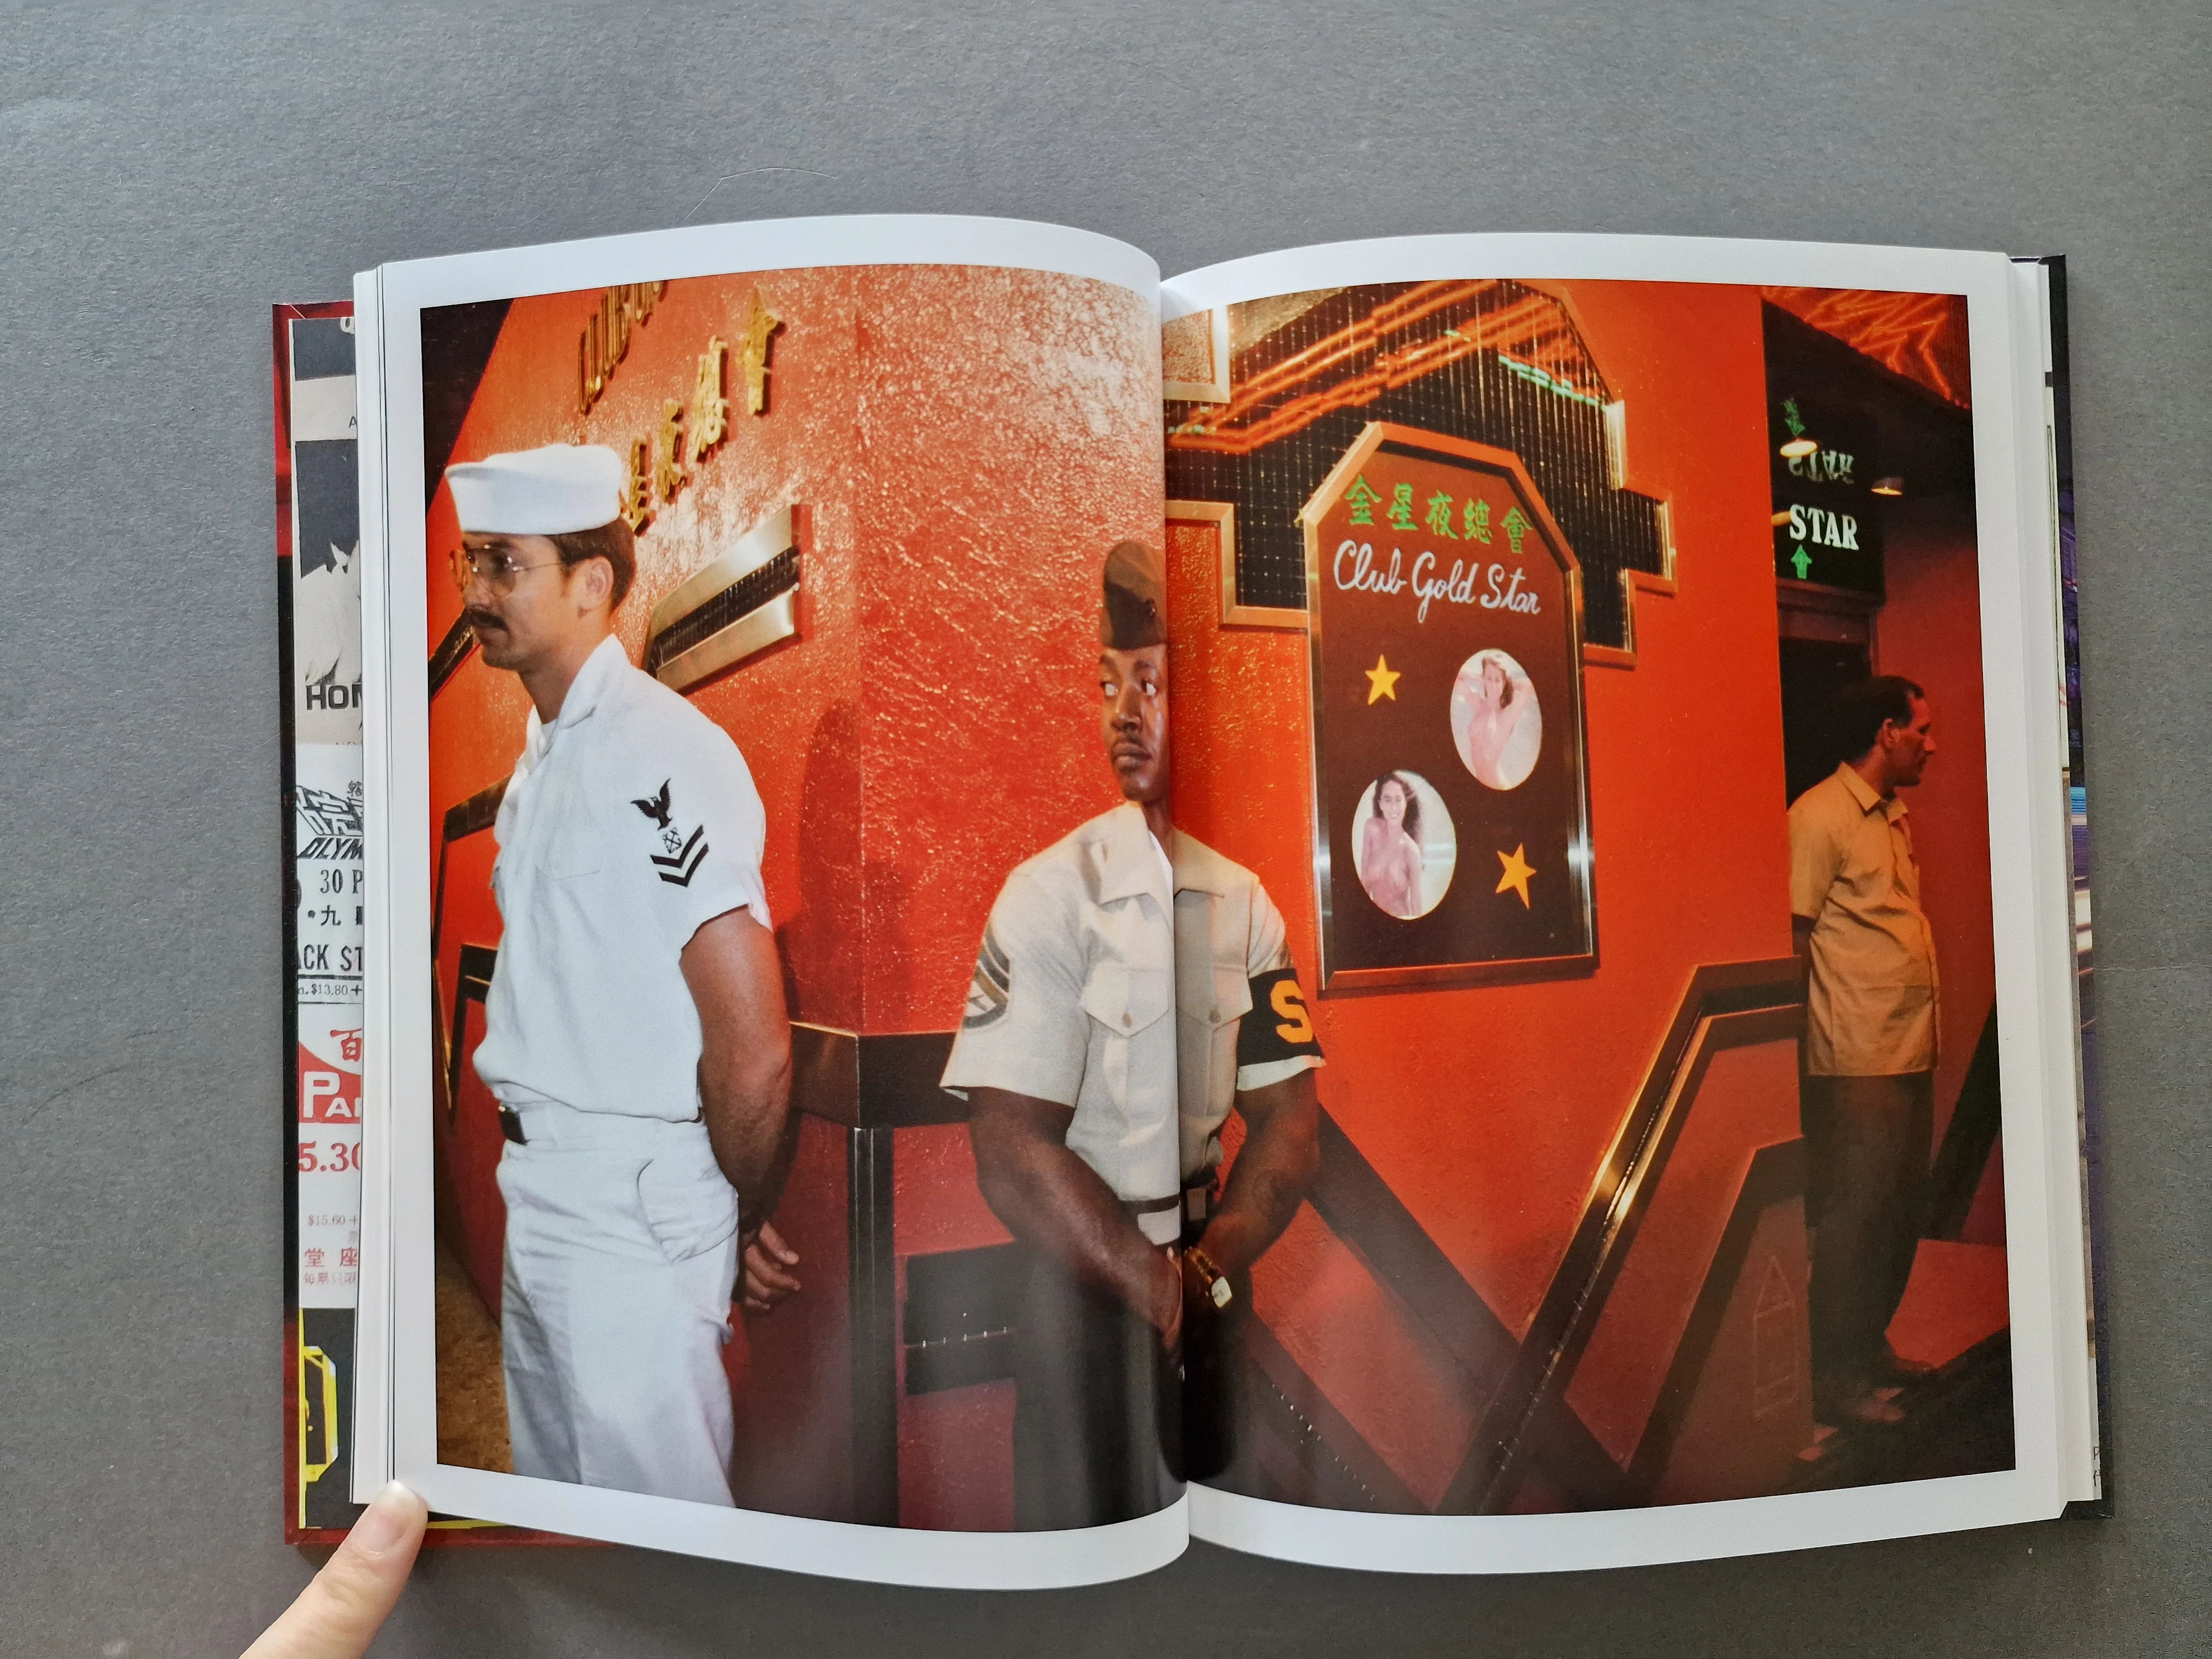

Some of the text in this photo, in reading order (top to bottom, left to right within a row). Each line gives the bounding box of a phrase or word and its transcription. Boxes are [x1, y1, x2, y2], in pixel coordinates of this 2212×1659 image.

[1344, 473, 1534, 554] 金星夜總會
[1788, 503, 1860, 551] STAR
[1333, 540, 1541, 624] Club Gold Star
[320, 869, 343, 894] 30
[1270, 980, 1313, 1044] S
